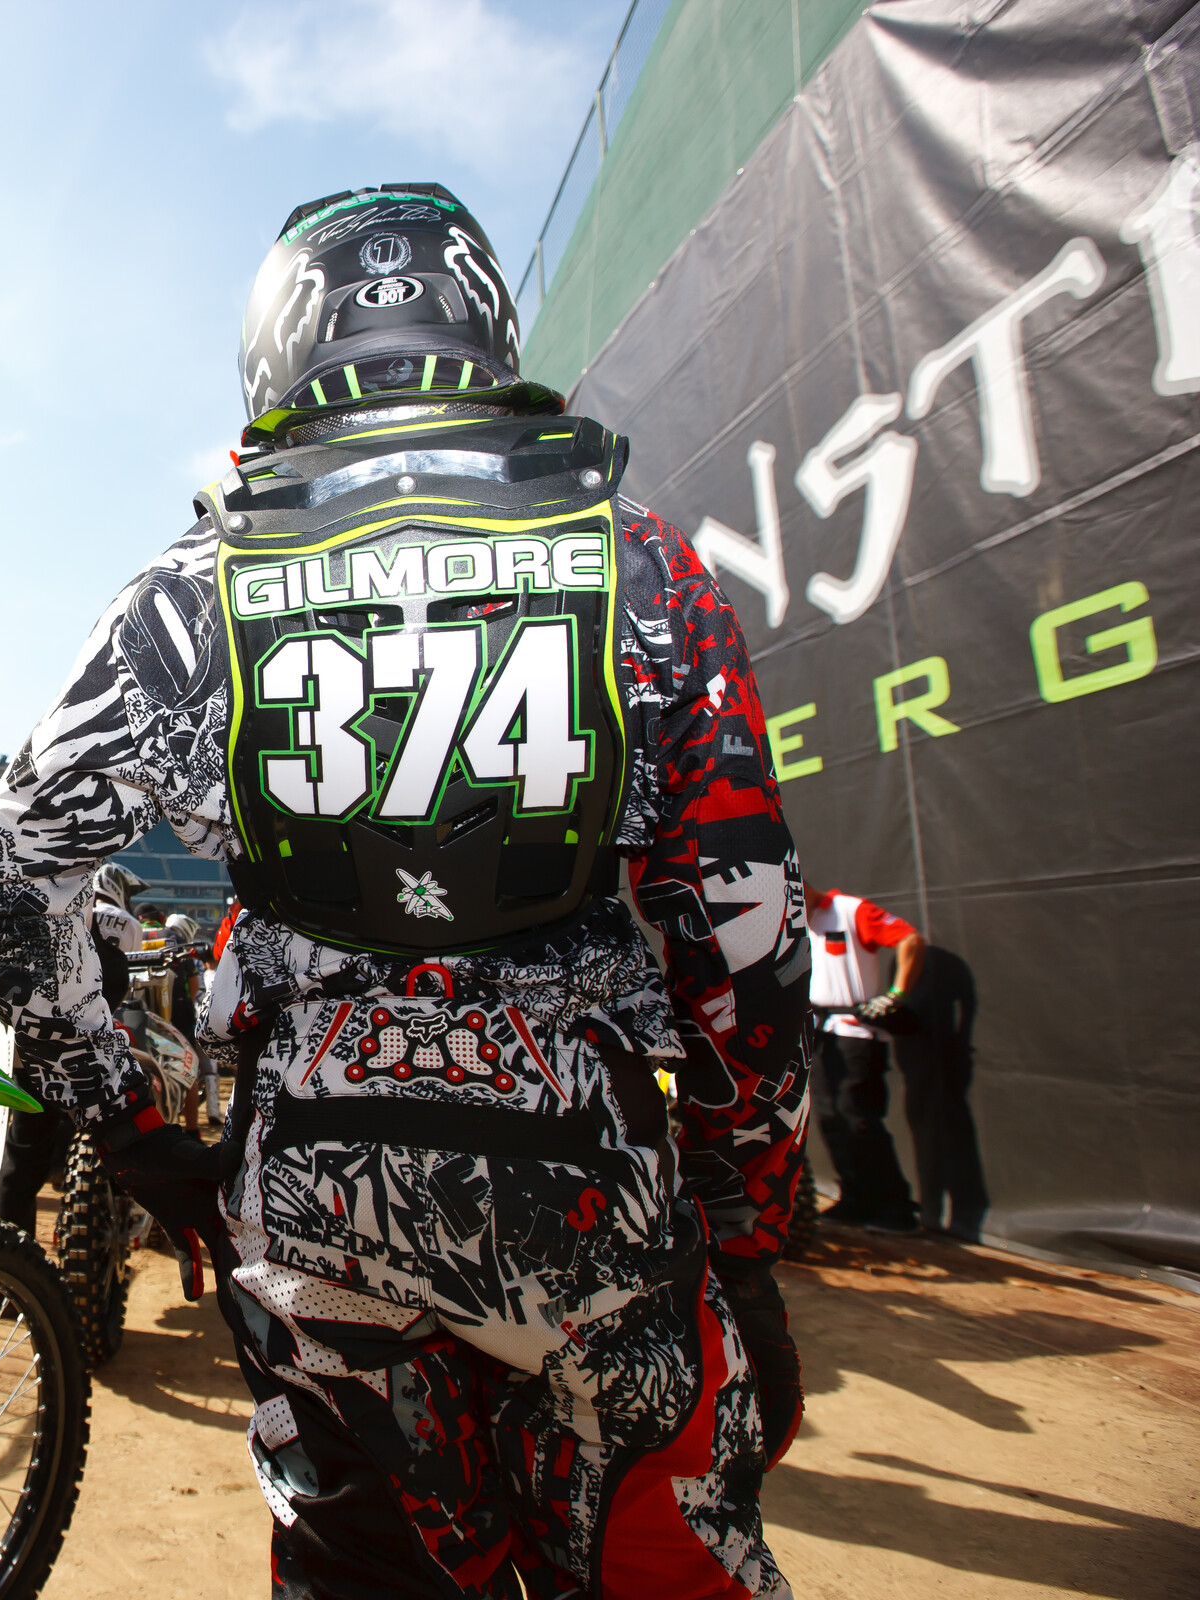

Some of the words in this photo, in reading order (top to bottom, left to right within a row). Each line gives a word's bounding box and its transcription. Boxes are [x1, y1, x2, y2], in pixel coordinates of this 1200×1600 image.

[378, 289, 406, 305] DOT
[234, 534, 607, 619] GILMORE
[256, 615, 595, 825] 374
